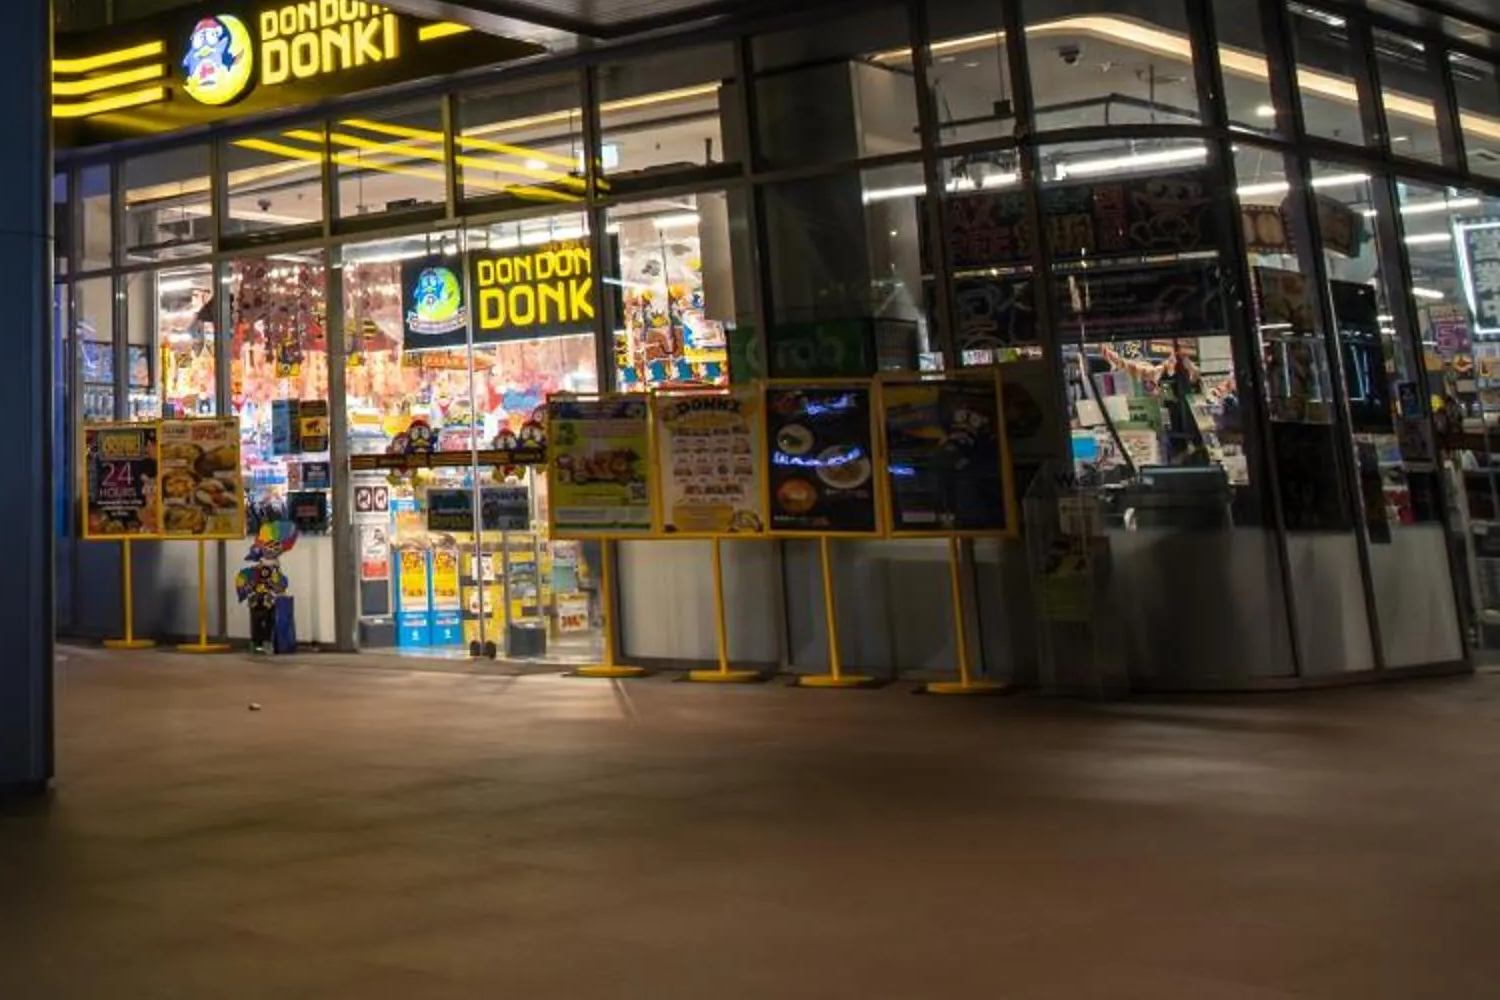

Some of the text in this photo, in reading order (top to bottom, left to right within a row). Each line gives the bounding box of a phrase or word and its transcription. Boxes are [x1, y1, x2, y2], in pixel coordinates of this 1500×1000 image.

[262, 13, 399, 85] DONKI
[479, 278, 594, 329] DONK
[102, 462, 134, 486] 24
